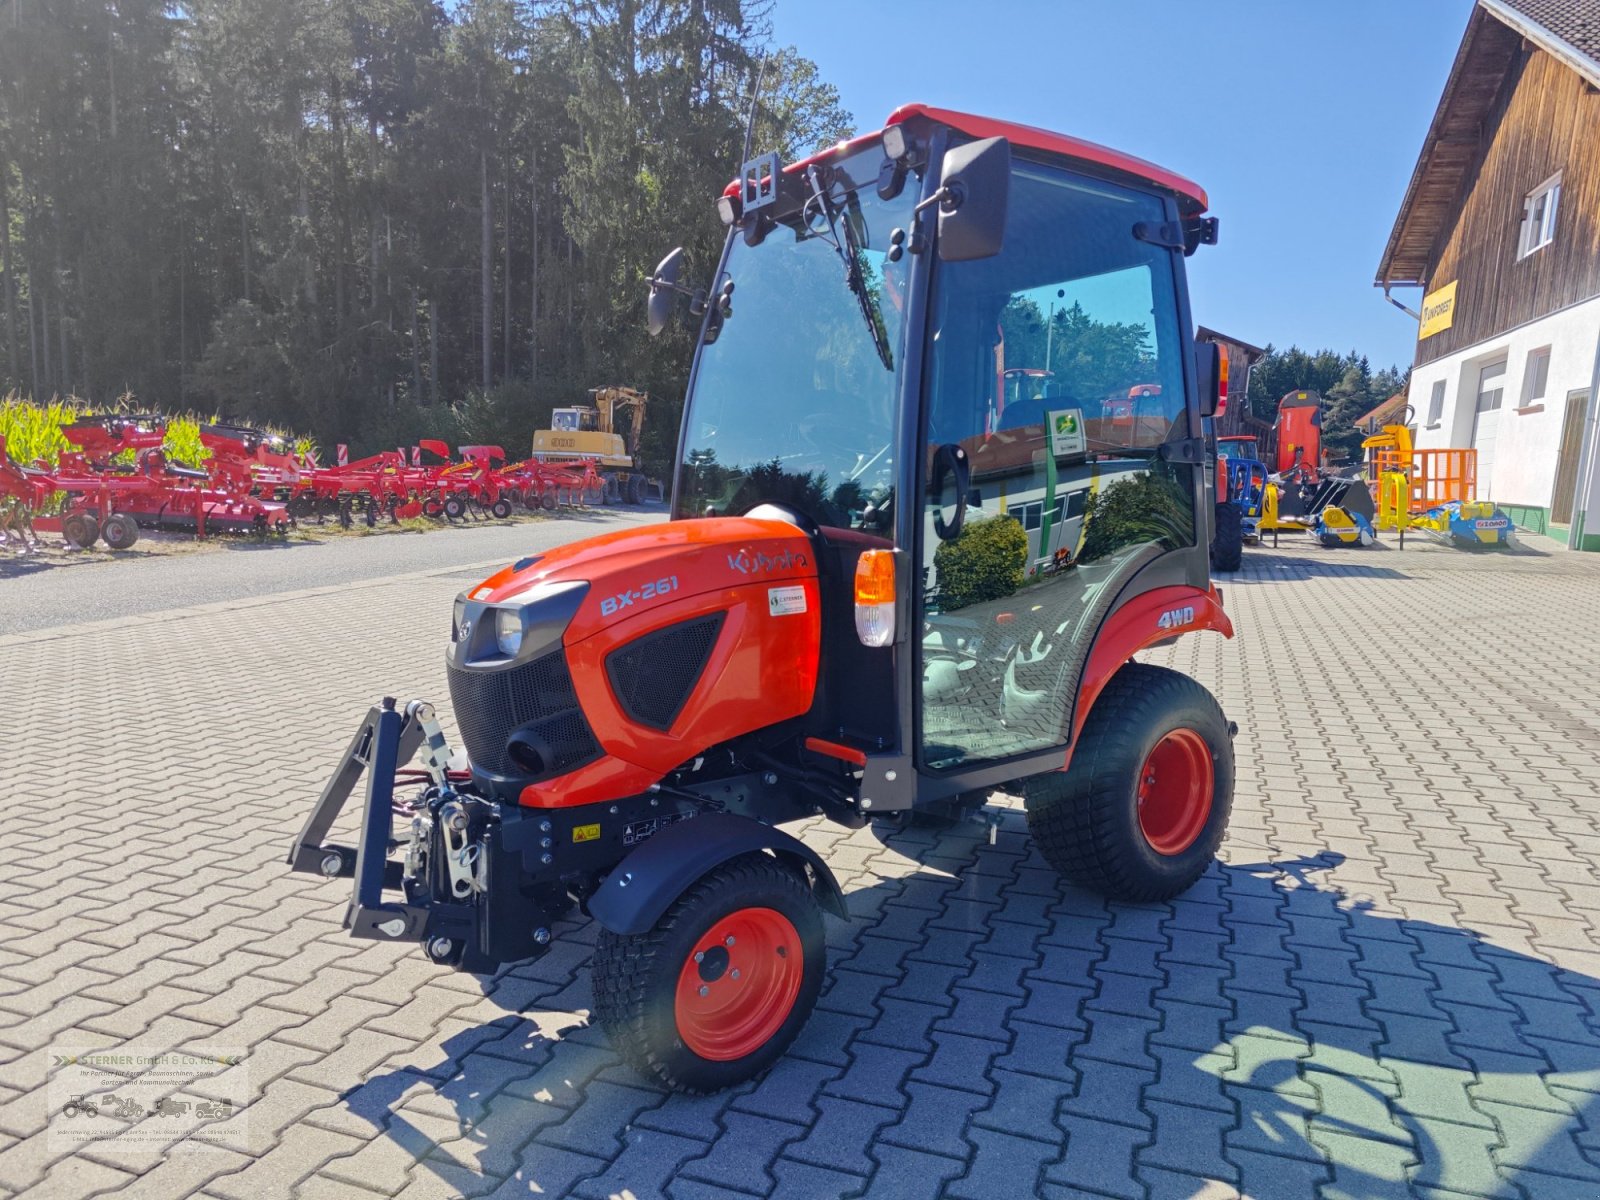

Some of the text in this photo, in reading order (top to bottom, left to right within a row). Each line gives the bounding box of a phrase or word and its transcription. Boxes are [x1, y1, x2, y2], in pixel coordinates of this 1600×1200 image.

[727, 550, 808, 574] Kubota
[600, 576, 678, 616] BX-261
[1157, 606, 1194, 628] 4WD
